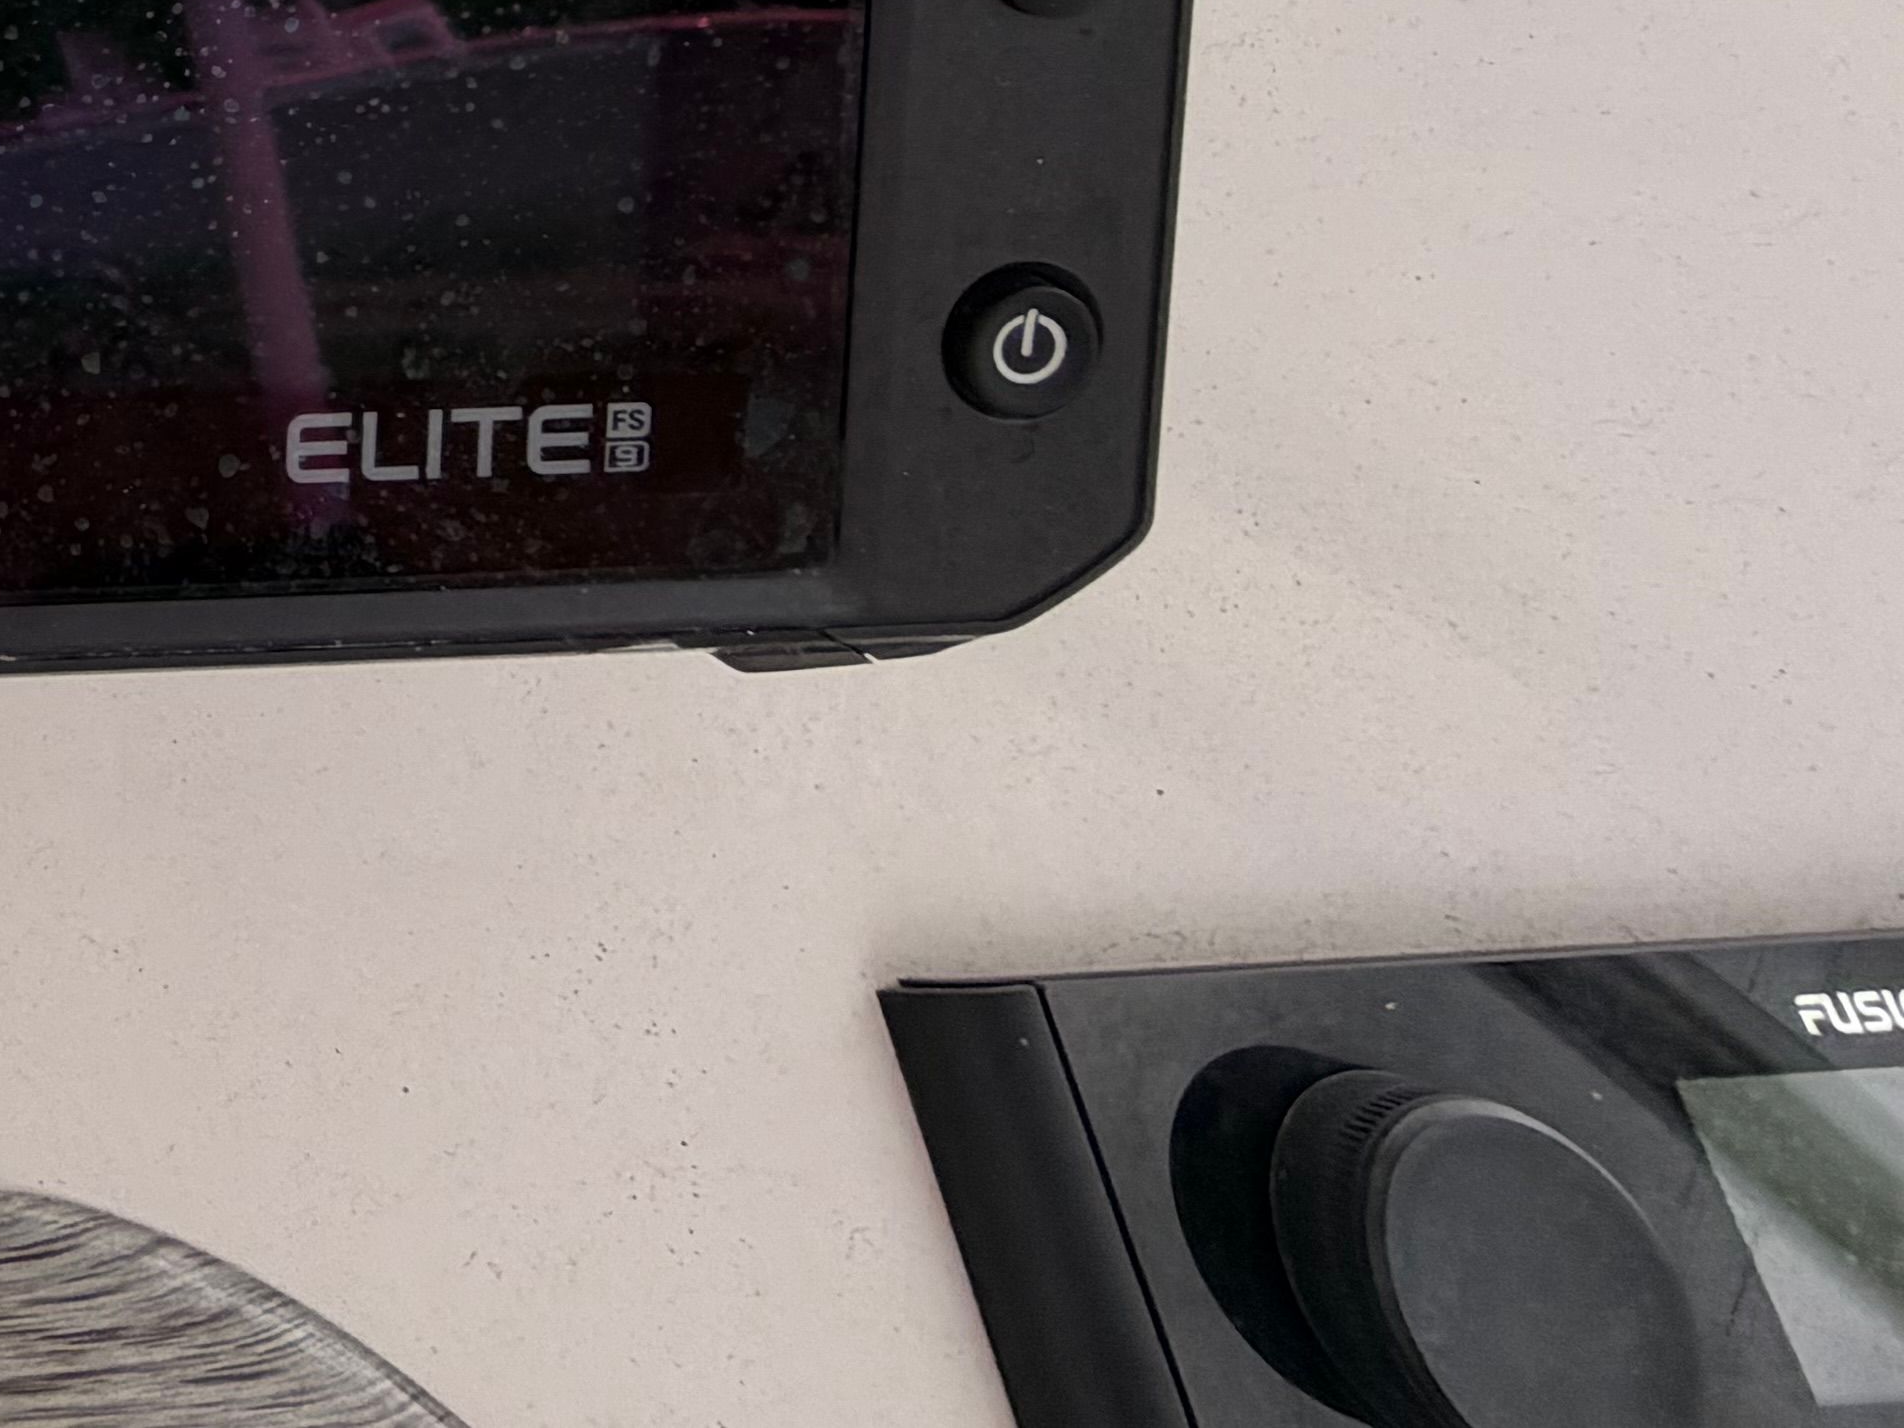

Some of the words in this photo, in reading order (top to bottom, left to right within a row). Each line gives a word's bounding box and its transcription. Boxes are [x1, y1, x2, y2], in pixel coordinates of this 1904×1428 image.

[286, 403, 593, 484] ELITE
[612, 409, 645, 432] FS
[615, 446, 638, 467] 9
[1794, 989, 1904, 1036] FUSI
